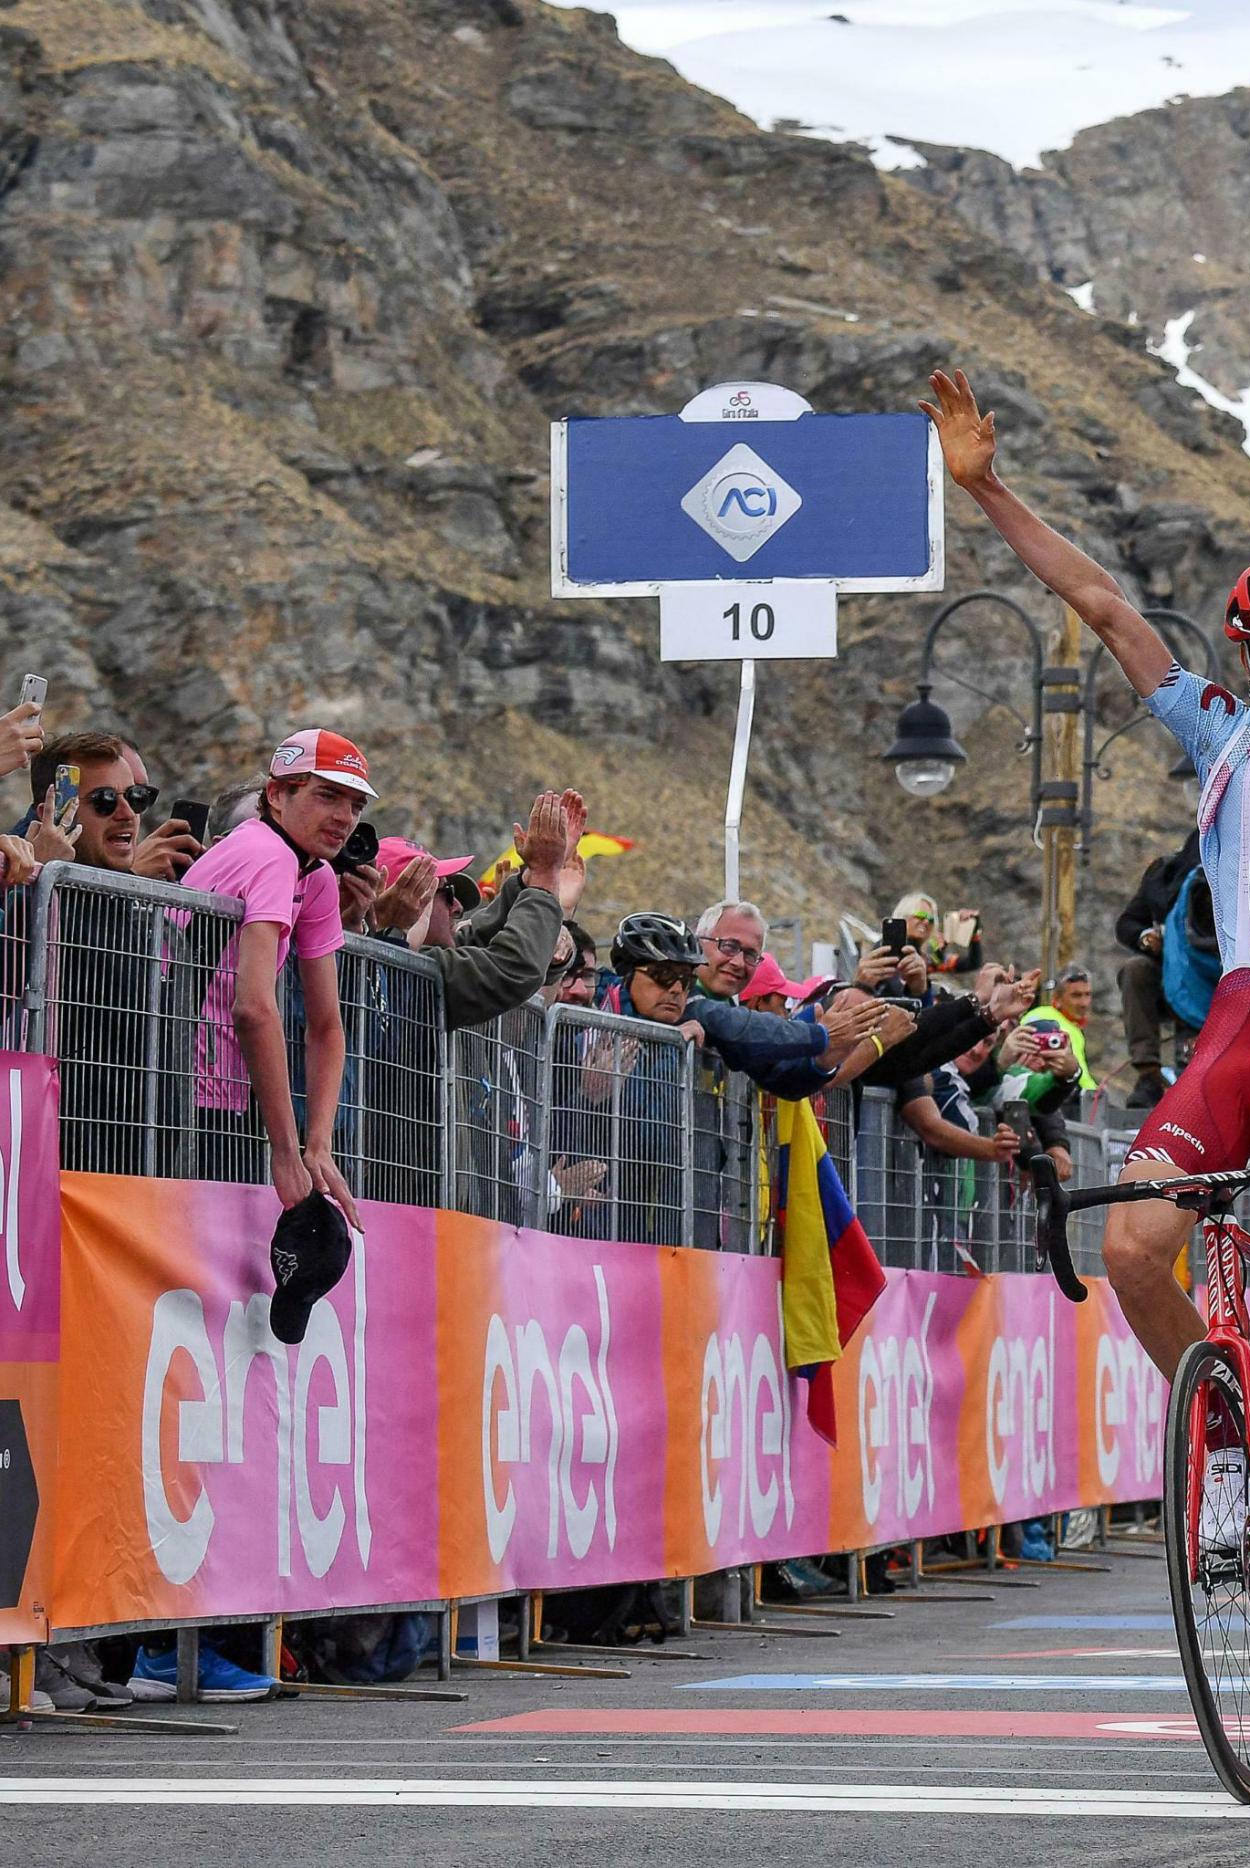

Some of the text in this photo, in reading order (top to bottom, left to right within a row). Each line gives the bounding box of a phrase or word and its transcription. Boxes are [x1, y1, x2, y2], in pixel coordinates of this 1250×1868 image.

[717, 487, 777, 518] ACI
[722, 603, 775, 641] 10
[1158, 1121, 1206, 1155] Alpecin
[142, 1228, 372, 1585] enel
[482, 1265, 618, 1565] enel
[701, 1280, 794, 1548] enel
[858, 1291, 935, 1525] enel
[986, 1291, 1056, 1506] enel
[1211, 1463, 1242, 1475] SIDI
